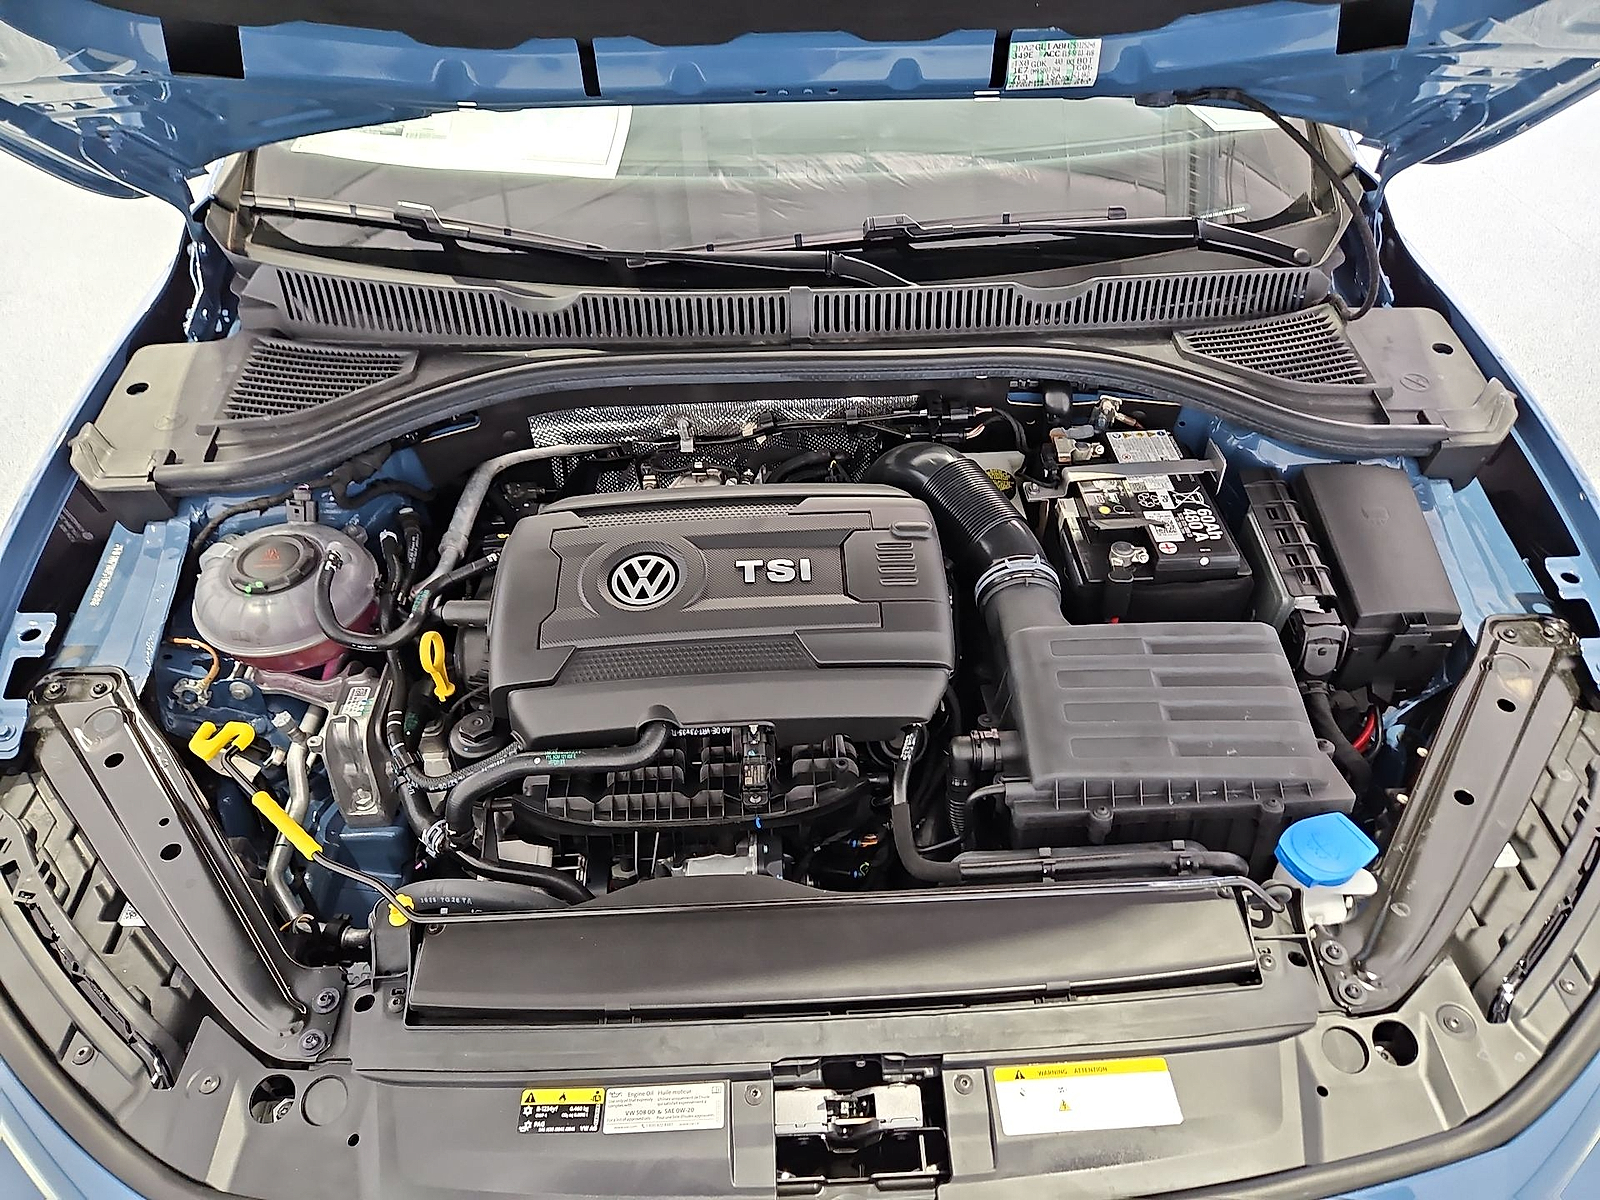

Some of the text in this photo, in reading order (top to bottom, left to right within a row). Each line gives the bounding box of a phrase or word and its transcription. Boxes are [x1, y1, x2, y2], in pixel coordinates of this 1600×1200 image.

[1182, 508, 1204, 530] 480
[1196, 508, 1224, 540] 60Ah
[735, 558, 812, 584] TSI
[1038, 1066, 1108, 1077] WARNING ATTENTION
